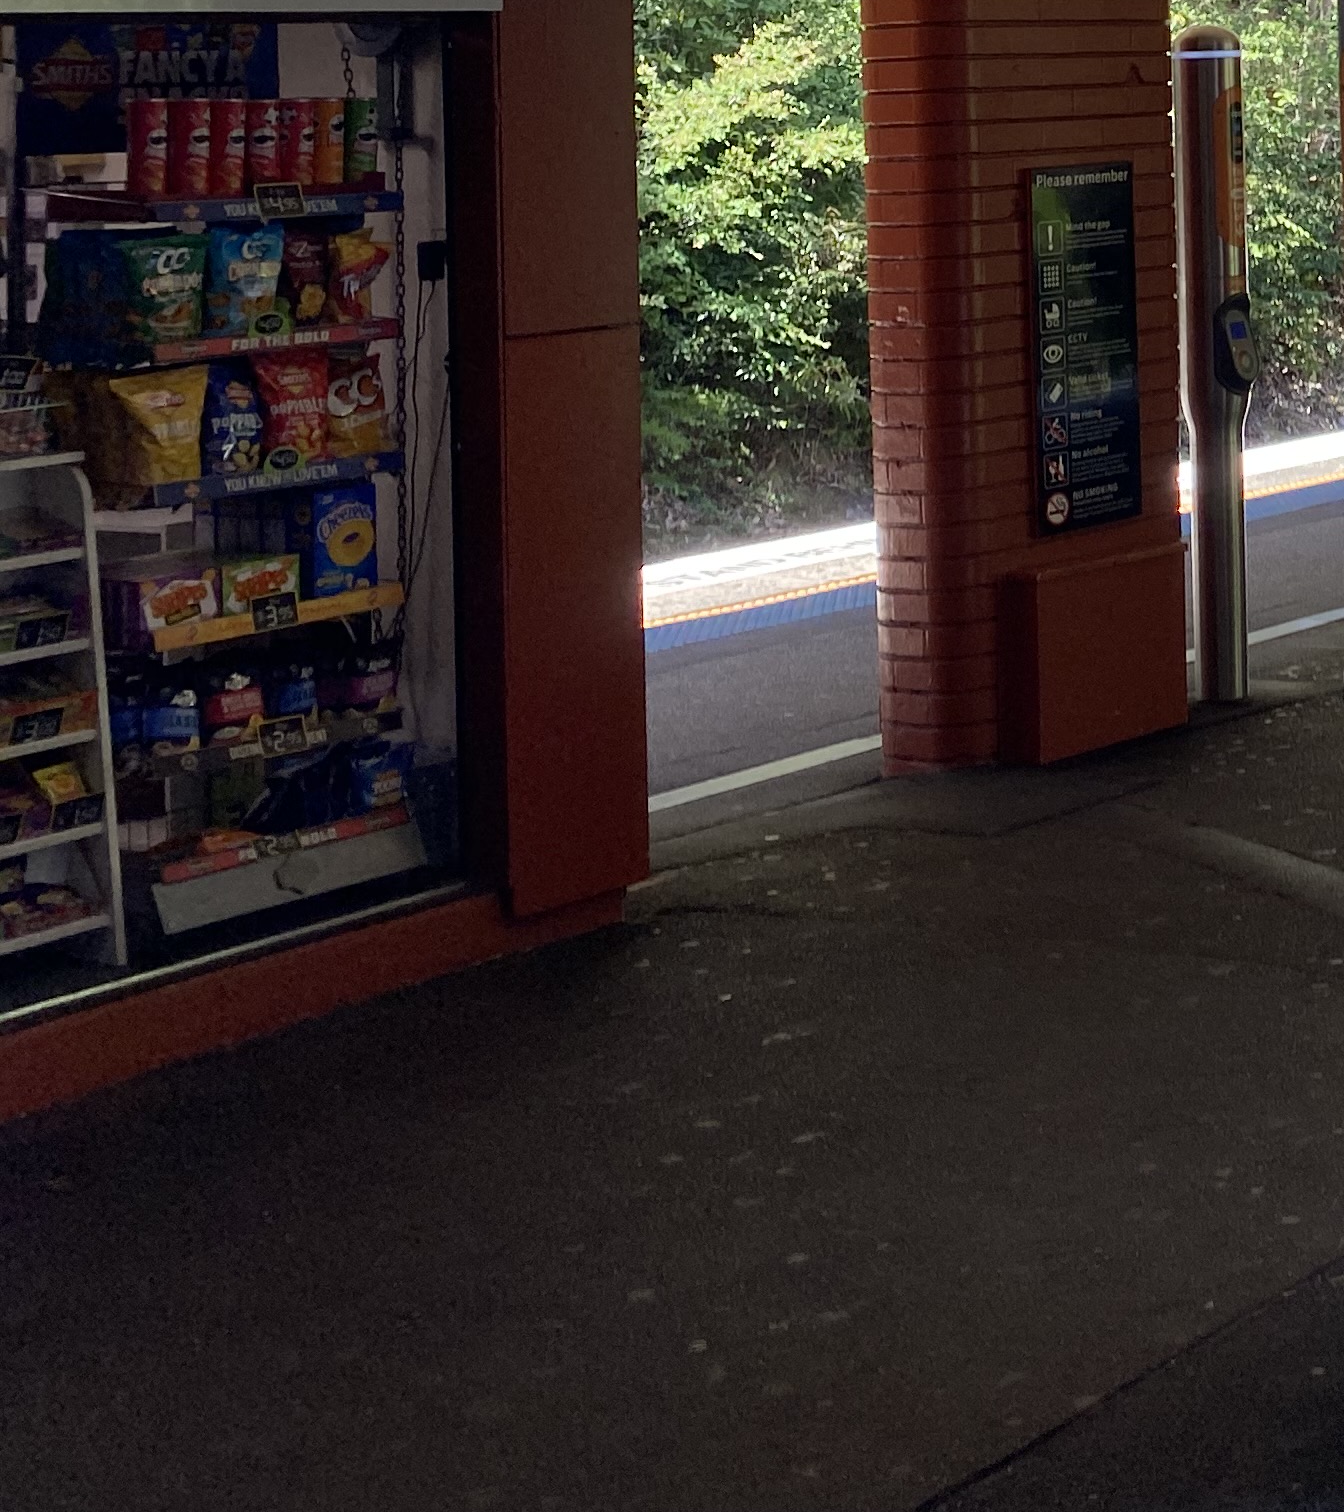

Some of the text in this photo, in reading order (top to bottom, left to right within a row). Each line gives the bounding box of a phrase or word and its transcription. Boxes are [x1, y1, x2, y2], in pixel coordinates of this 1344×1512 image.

[119, 49, 219, 85] FANCY
[1036, 168, 1128, 188] Please remember
[231, 338, 260, 351] FOR
[224, 477, 246, 492] YOU
